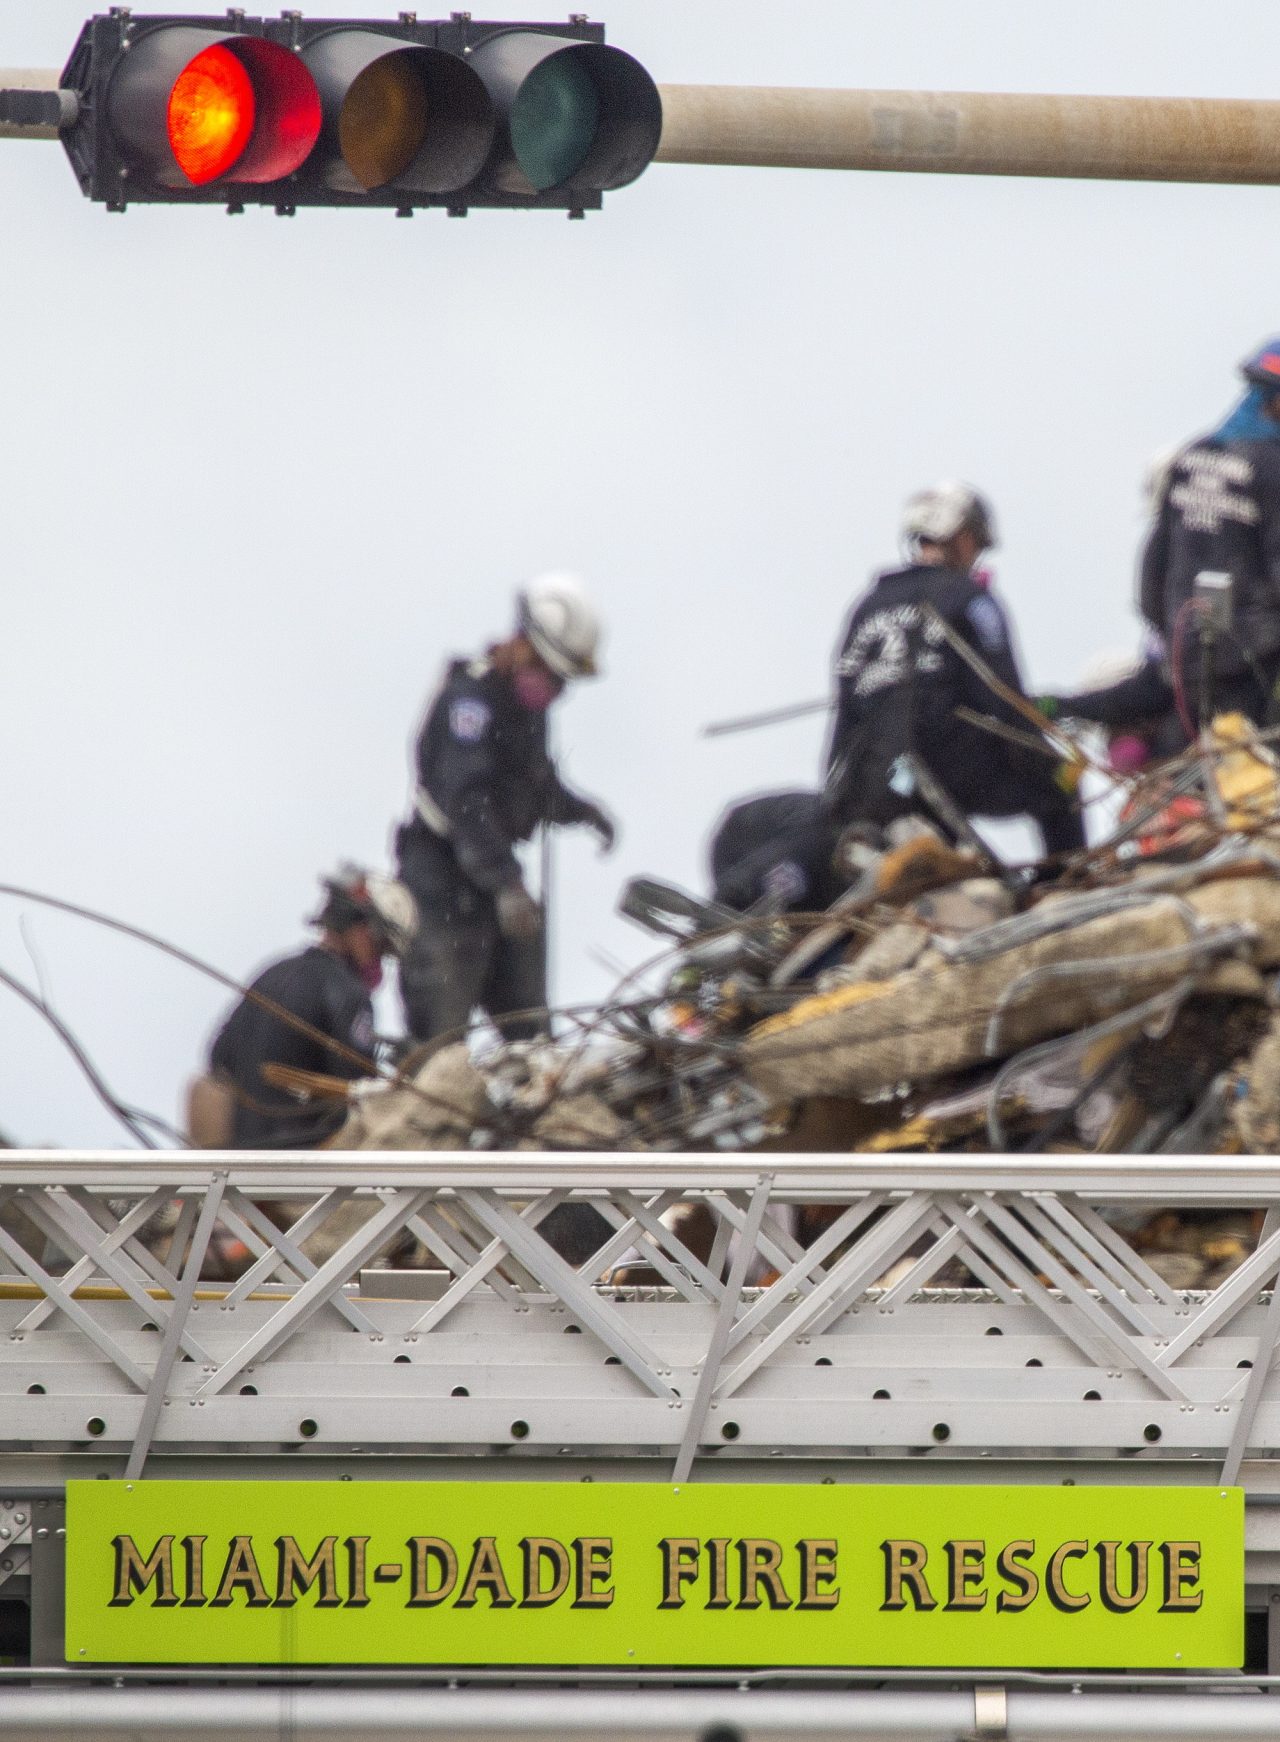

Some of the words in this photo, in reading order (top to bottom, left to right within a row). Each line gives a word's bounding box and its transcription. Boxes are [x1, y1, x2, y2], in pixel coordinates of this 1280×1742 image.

[107, 1535, 615, 1609] MIAMI-DADE
[657, 1537, 841, 1610] FIRE
[879, 1539, 1204, 1613] RESCUE
